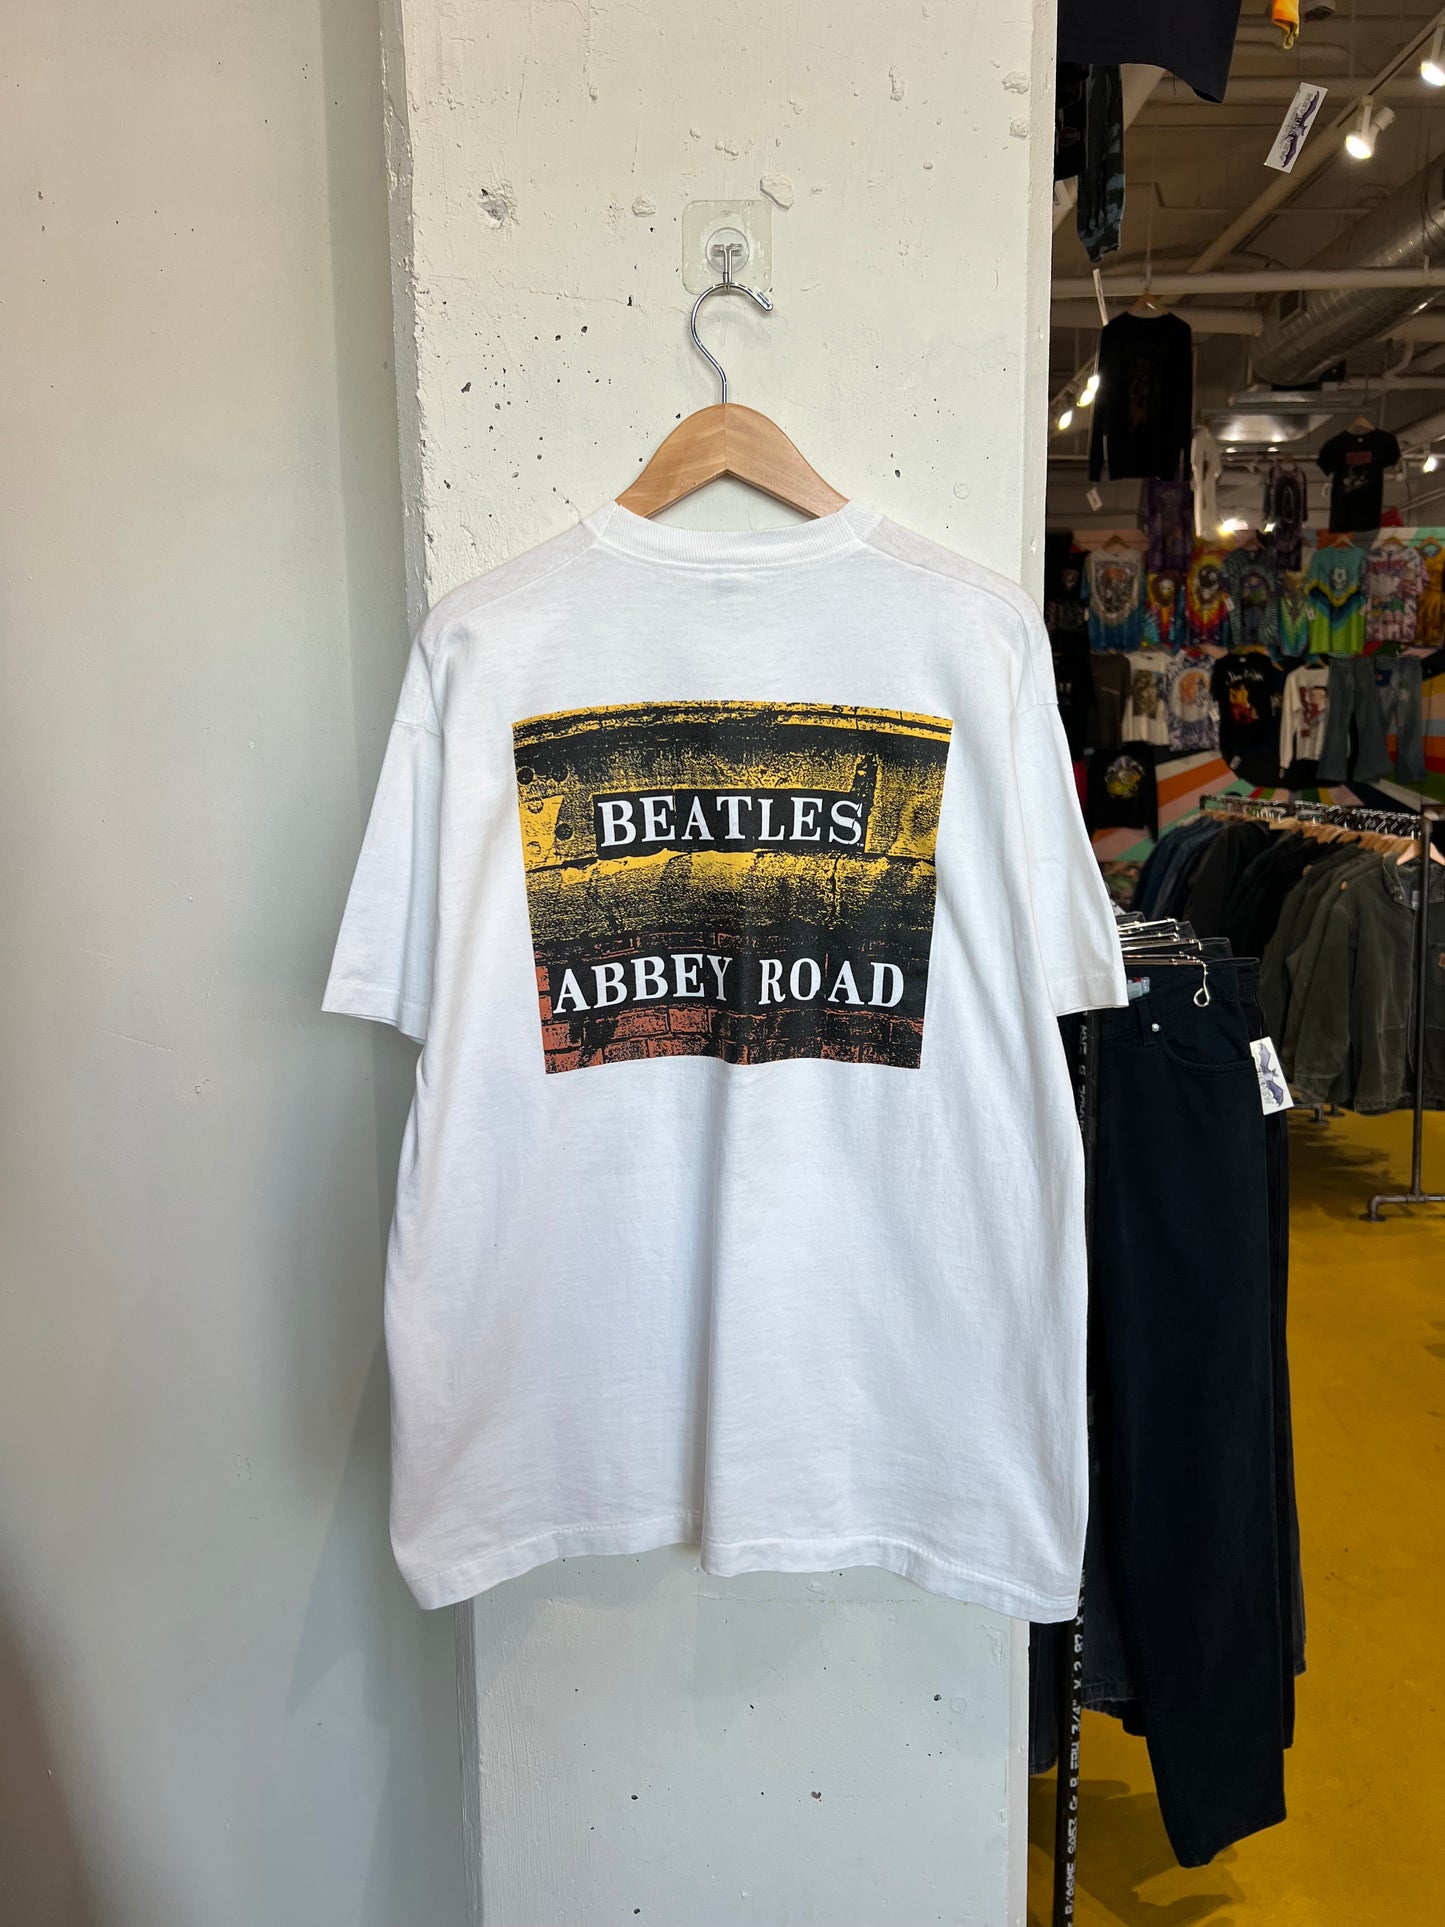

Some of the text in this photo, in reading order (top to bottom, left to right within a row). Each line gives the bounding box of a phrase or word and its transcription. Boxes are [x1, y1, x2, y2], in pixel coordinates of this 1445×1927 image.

[597, 795, 863, 847] BEATLES
[552, 953, 905, 1014] ABBEY ROAD
